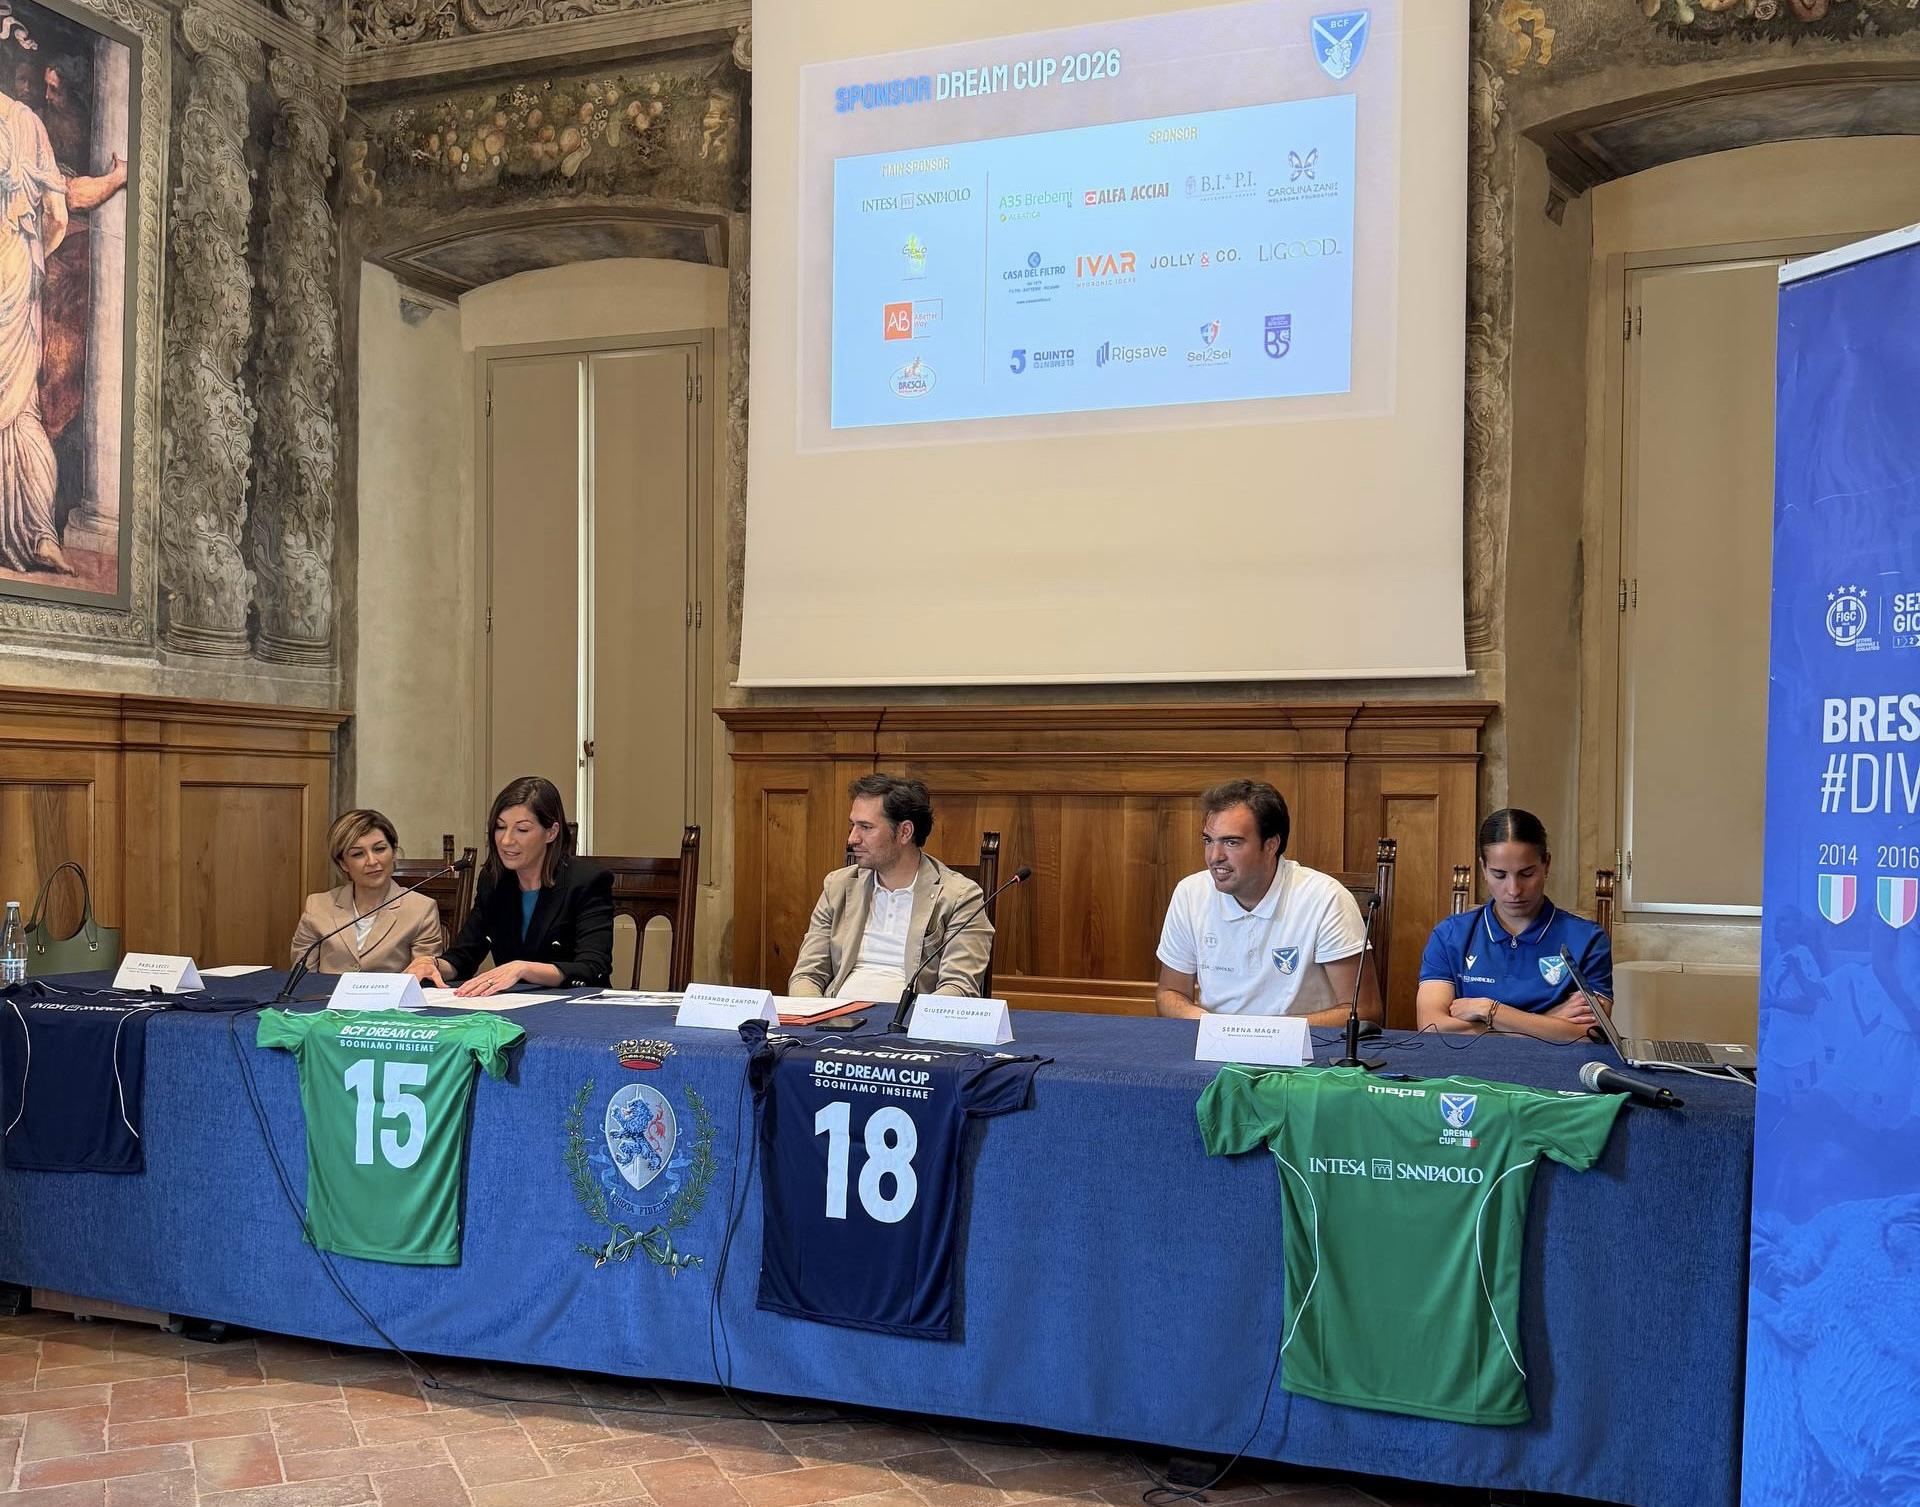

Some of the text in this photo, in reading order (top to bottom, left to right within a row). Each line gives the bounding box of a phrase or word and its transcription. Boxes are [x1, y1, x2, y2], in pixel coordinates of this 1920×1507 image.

[1330, 18, 1350, 29] BCF
[834, 48, 1121, 114] SPONSOR DREAM CUP 2026
[1148, 126, 1198, 144] SPONSOR
[905, 157, 951, 175] SPONSOR
[862, 187, 971, 212] INTESA SANPAOLO
[999, 188, 1072, 209] A35 Brebemi
[1098, 182, 1169, 205] ALFA ACCIAI
[1267, 185, 1312, 198] CAROLINA
[1076, 251, 1136, 279] IVAR
[1150, 248, 1241, 269] JOLLY & CO.
[1003, 265, 1066, 280] CASA DEL FILTRO
[888, 310, 910, 333] AB
[1033, 349, 1075, 361] QUINTO
[1112, 345, 1168, 363] Rigsave
[898, 380, 927, 390] BRESCIA
[1836, 611, 1857, 622] FIGC
[1822, 694, 1920, 744] BRES
[1818, 844, 1920, 869] 2014 2016
[690, 994, 730, 1004] ALESSANDRO
[924, 1007, 992, 1017] GIUSEPPE LOMBARDI
[340, 1025, 439, 1040] BCF DREAM CUP
[1222, 1026, 1252, 1034] SERENA
[340, 1039, 434, 1053] SOGNIAMO INSIEME
[814, 1060, 930, 1086] BCF DREAM CUP
[814, 1078, 929, 1100] SOGNIAMO INSIEME
[344, 1059, 429, 1169] 15
[1439, 1136, 1456, 1146] CUP
[1442, 1128, 1473, 1138] DREAM
[815, 1101, 918, 1224] 18
[1309, 1157, 1484, 1184] INTESA SANPAOLO
